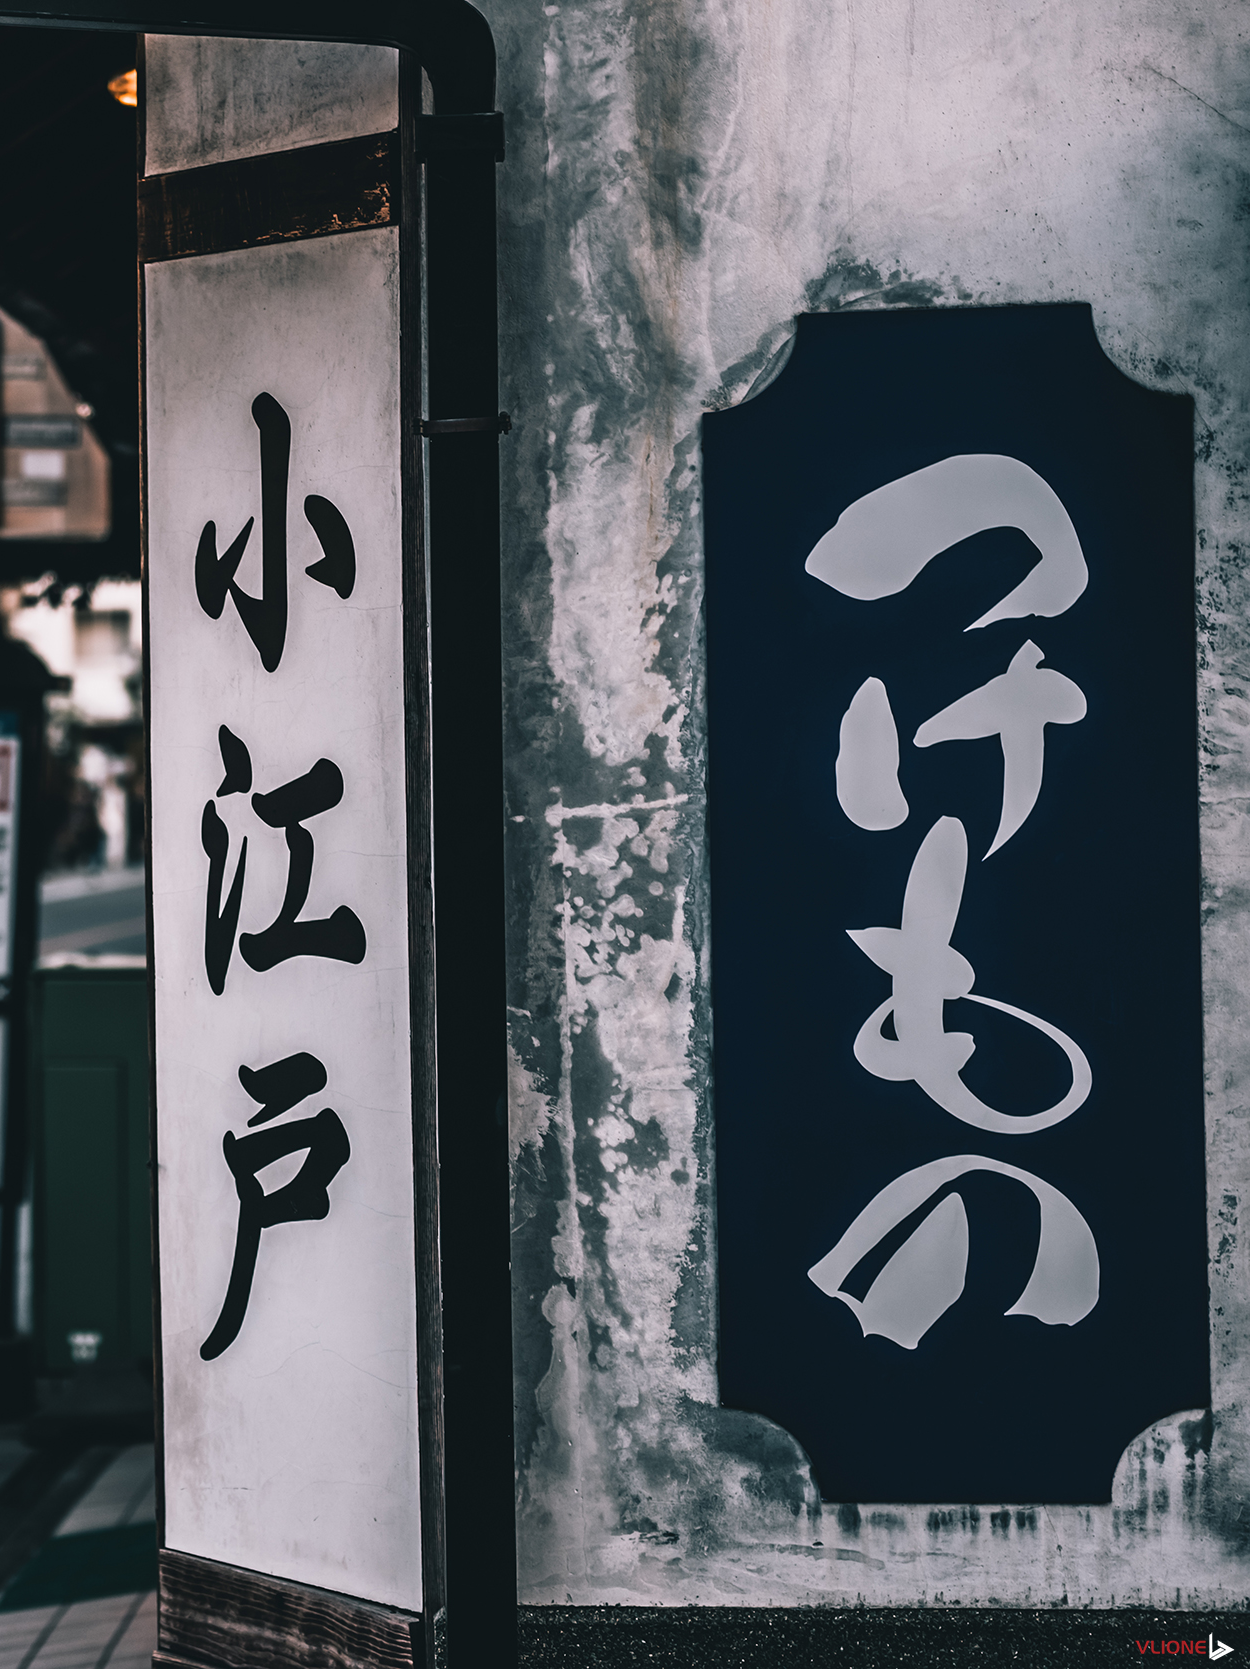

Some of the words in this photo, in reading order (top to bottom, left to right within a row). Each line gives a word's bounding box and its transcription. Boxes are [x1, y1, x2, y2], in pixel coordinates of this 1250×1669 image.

[195, 392, 367, 1361] 小江戸
[805, 453, 1101, 1350] つけもの
